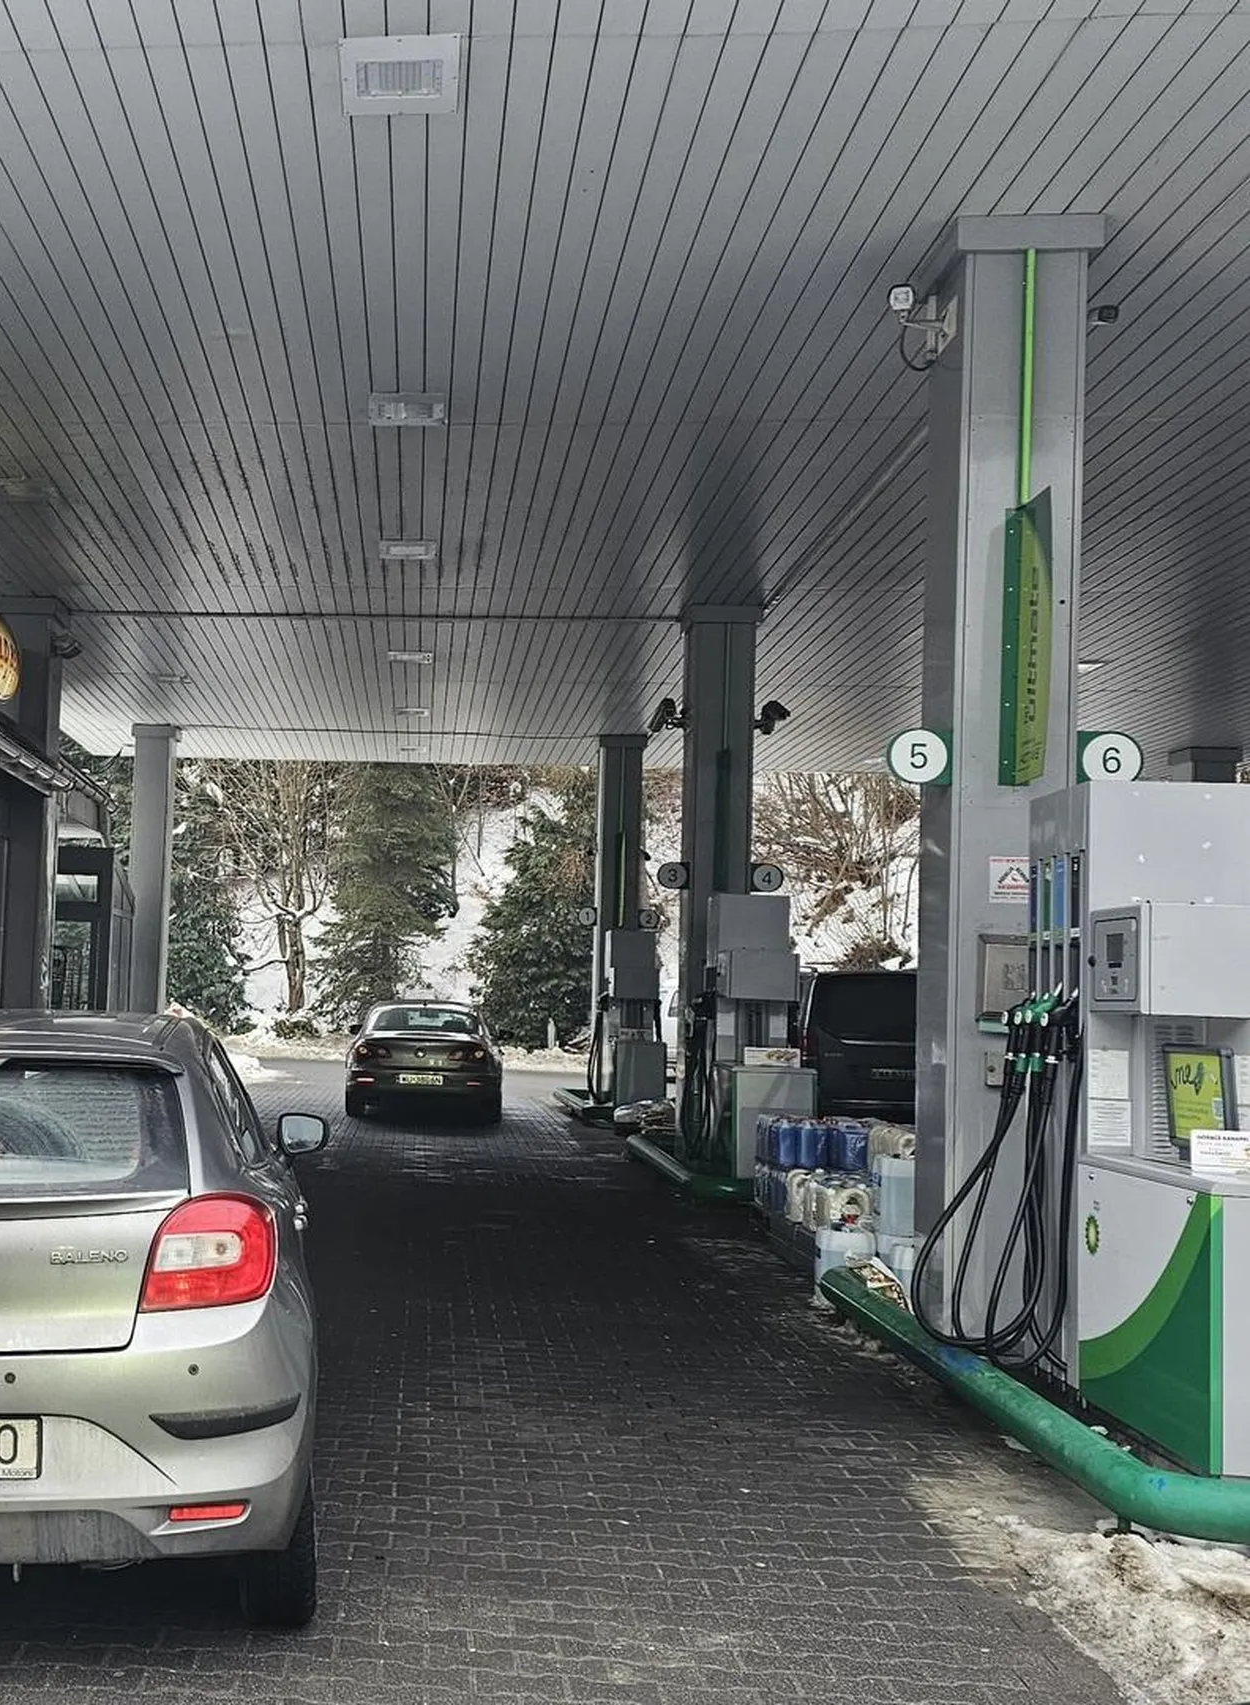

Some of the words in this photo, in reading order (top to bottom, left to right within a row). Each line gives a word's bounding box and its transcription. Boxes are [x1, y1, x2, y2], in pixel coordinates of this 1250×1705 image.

[910, 743, 928, 769] 5
[1102, 747, 1121, 774] 6
[667, 869, 678, 882] 3
[761, 871, 772, 885] 4
[645, 914, 653, 924] 2
[49, 1249, 129, 1266] BALENO
